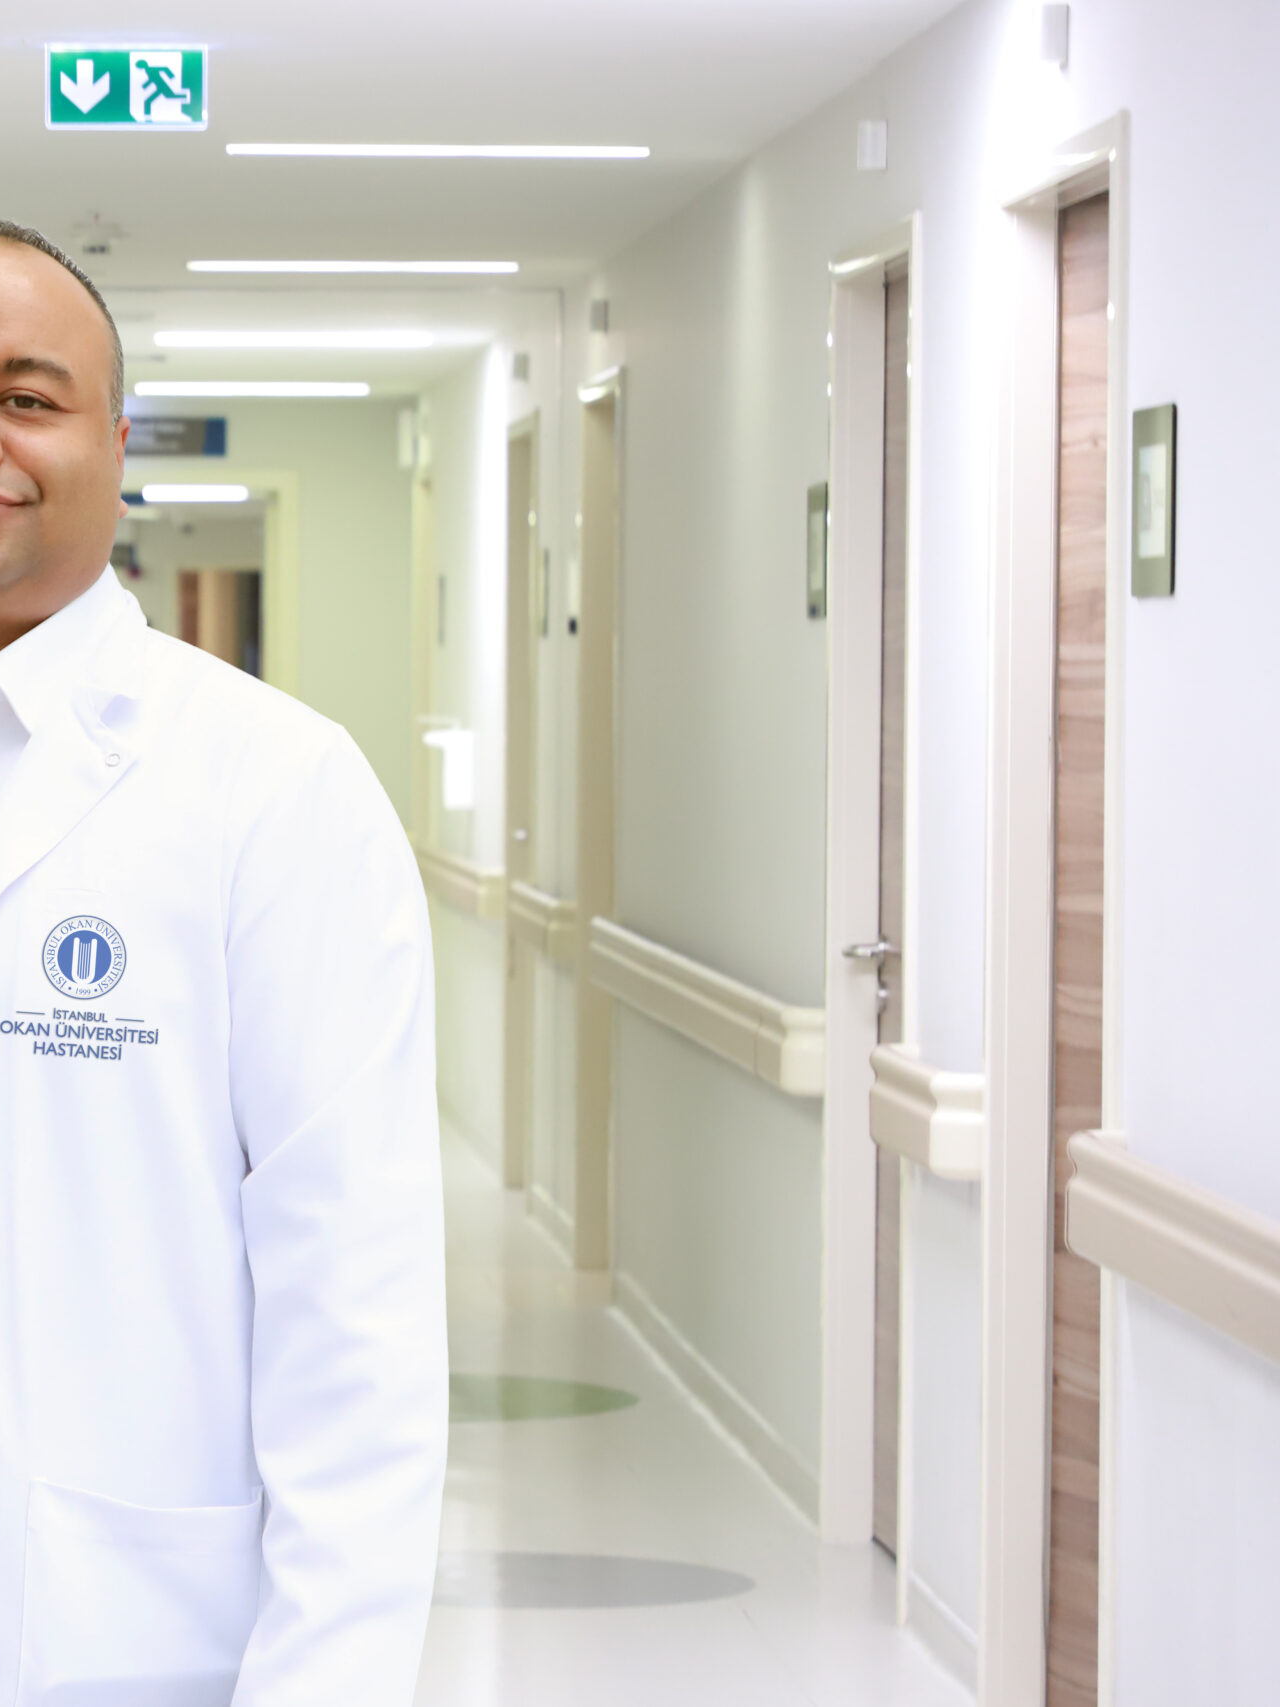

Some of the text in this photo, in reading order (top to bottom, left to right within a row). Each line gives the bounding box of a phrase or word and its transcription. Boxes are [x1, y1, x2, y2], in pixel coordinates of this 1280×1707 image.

[46, 919, 123, 992] İSTANBUL OKAN ÜNİVERSİTESİ
[75, 987, 91, 996] 1999
[52, 1007, 108, 1023] İSTANBUL
[0, 1020, 159, 1045] OKAN ÜNİVERSİTESİ
[33, 1041, 122, 1061] HASTANESİ
